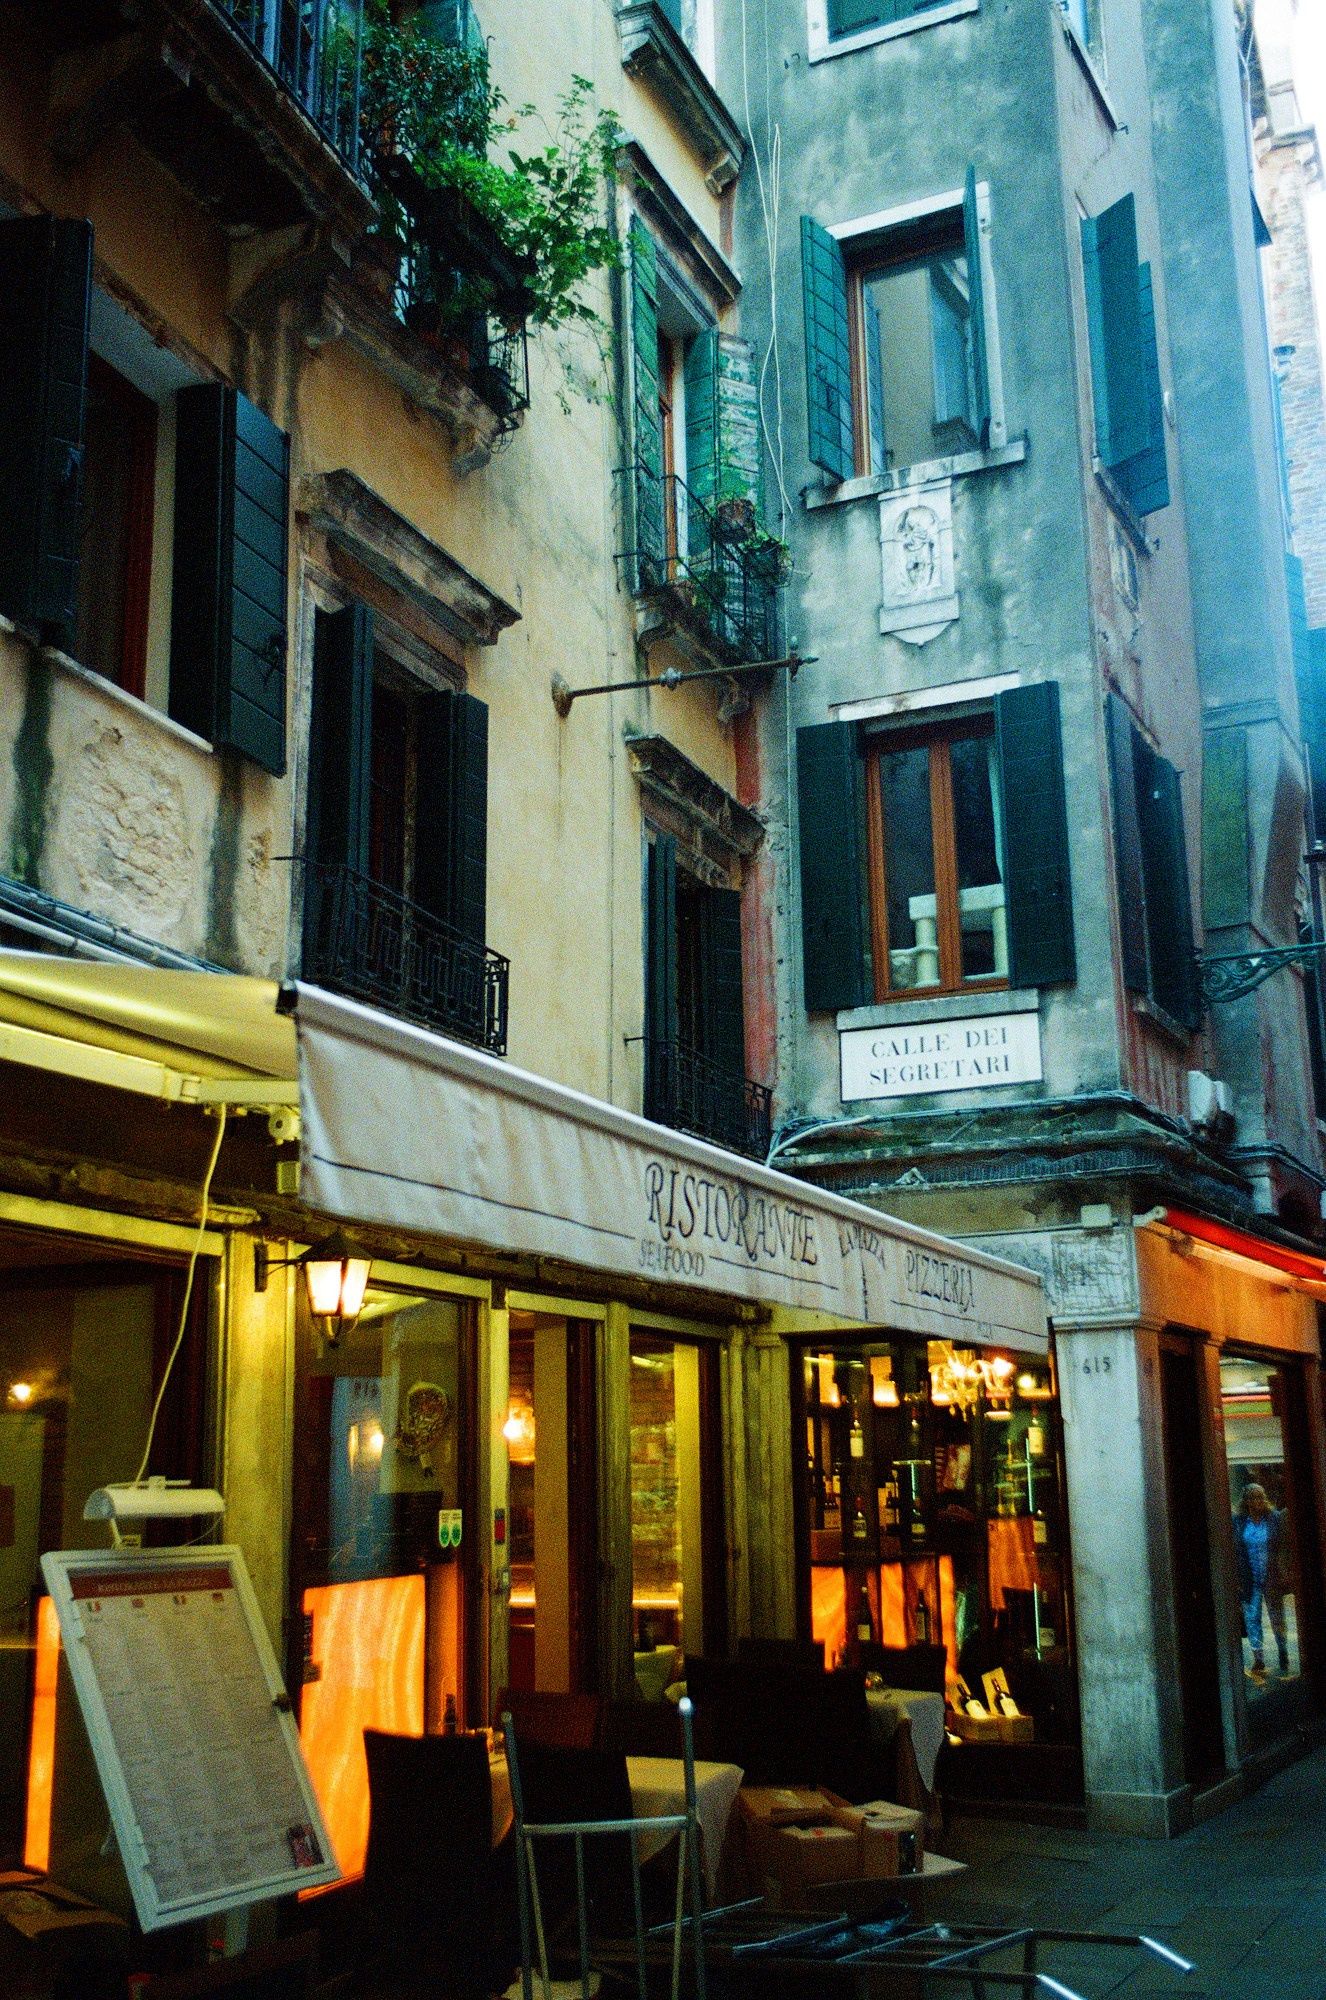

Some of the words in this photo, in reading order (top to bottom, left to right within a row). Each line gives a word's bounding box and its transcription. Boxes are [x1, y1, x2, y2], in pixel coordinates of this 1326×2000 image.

[871, 1034, 950, 1059] CALLE
[965, 1026, 1008, 1049] DEI
[869, 1054, 1011, 1086] SEGRETARI
[644, 1161, 818, 1266] RISTORANTE
[637, 1238, 706, 1278] SEAFOOD
[906, 1249, 975, 1313] PIZZERIA
[1082, 1356, 1111, 1374] 615
